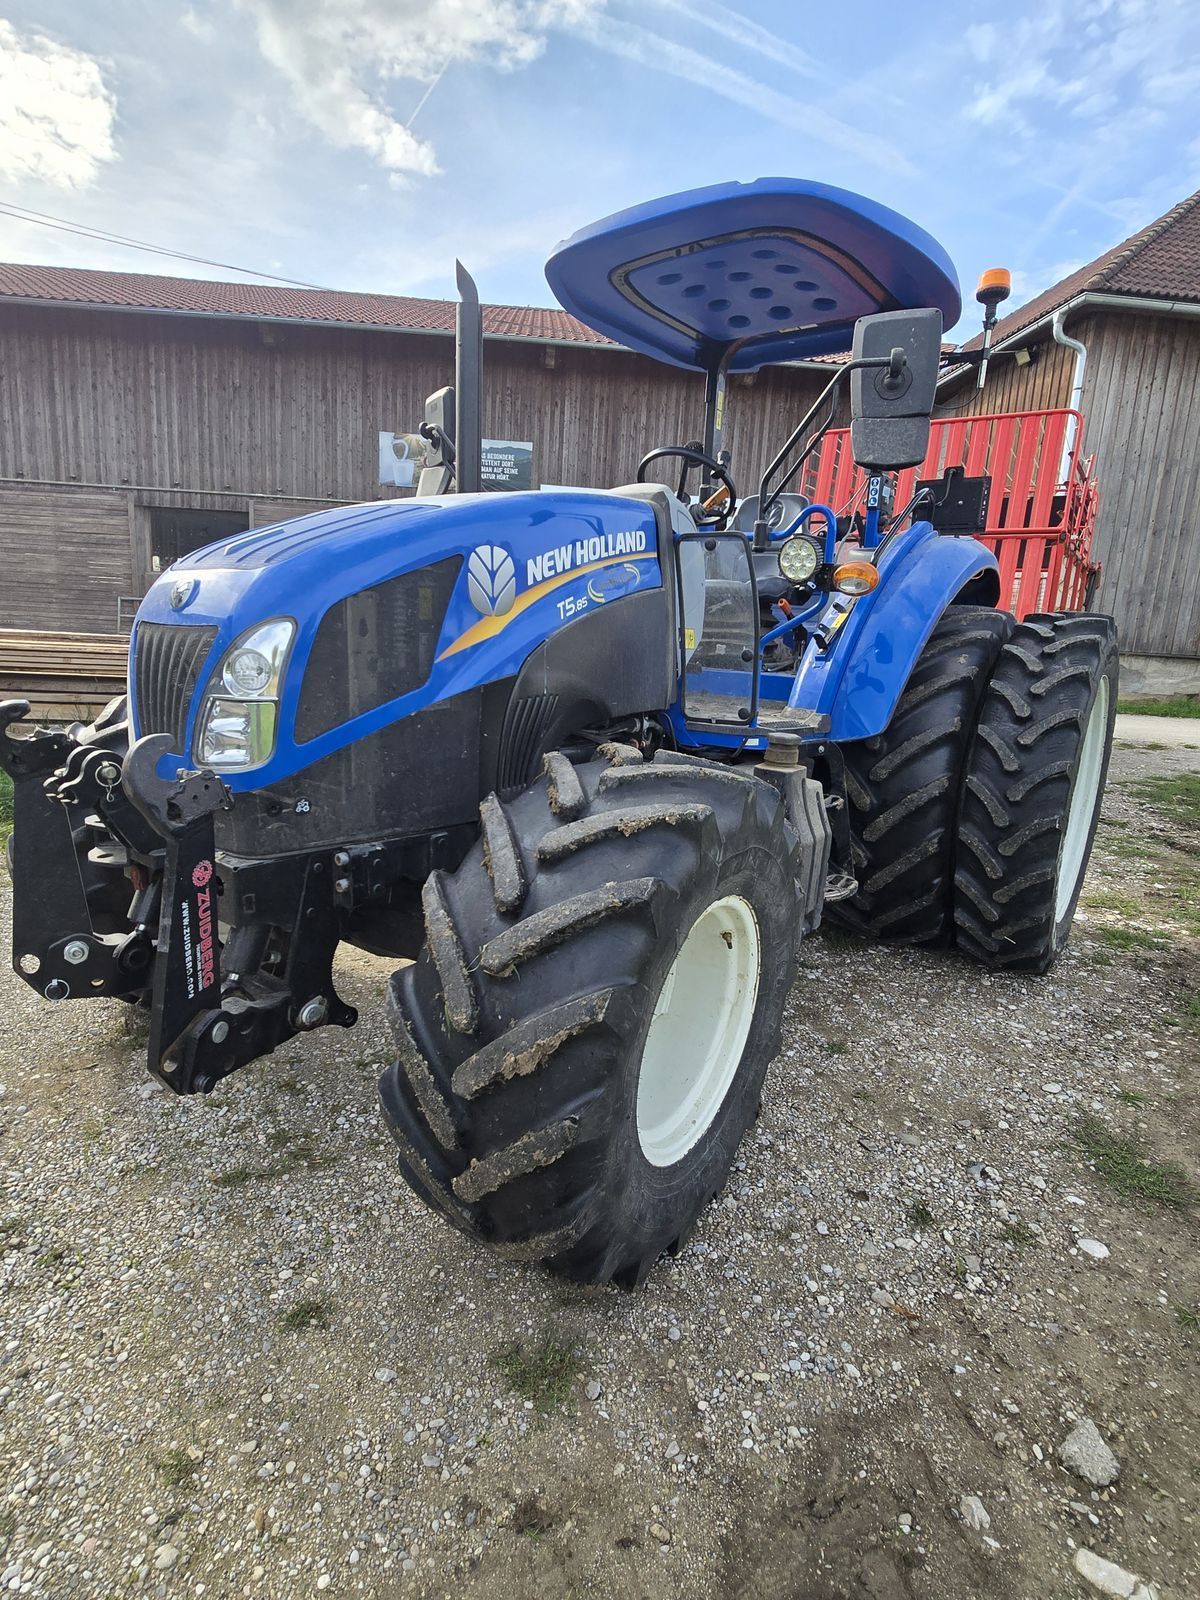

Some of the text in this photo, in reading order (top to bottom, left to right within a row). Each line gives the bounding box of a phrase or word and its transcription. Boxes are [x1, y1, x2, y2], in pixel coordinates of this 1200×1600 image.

[487, 453, 515, 461] BESONDERE
[527, 544, 573, 586] NEW
[575, 531, 647, 565] HOLLAND
[557, 597, 588, 620] T5.85
[198, 888, 214, 988] ZUIDBERG
